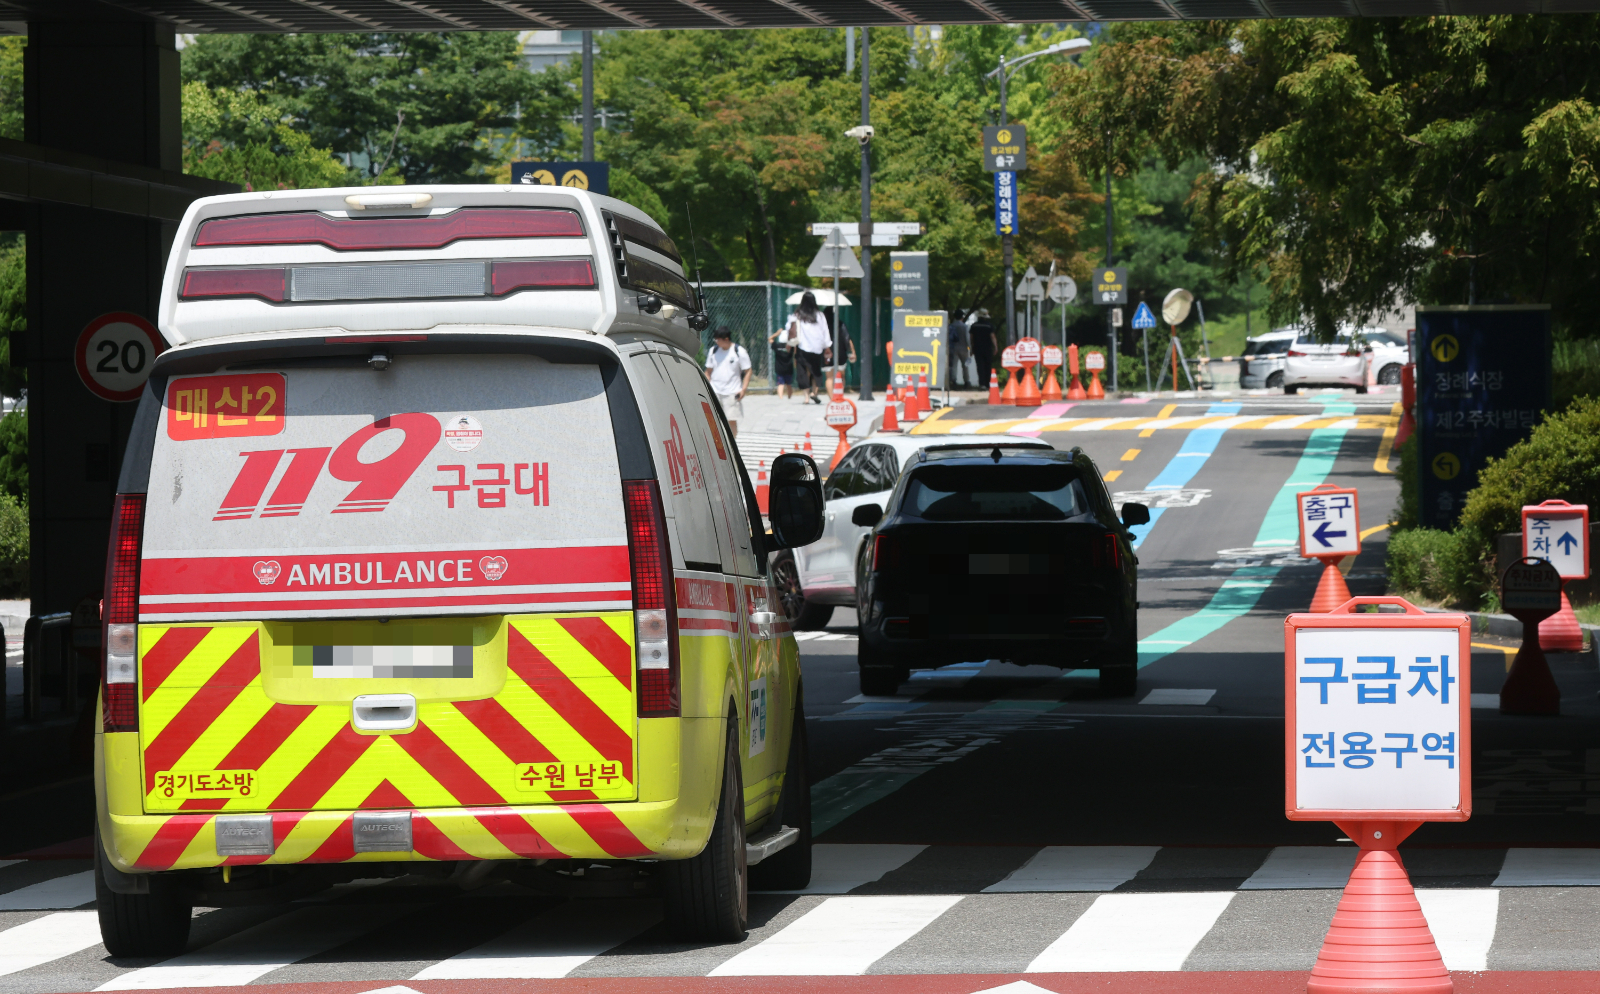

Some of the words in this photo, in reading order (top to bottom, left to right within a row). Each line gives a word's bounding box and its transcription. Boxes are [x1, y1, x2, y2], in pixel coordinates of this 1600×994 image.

[995, 156, 1016, 168] 출구
[998, 171, 1014, 226] 장례식장
[922, 327, 940, 337] 출구
[97, 340, 146, 374] 20
[1435, 370, 1503, 391] 장례식장
[174, 384, 277, 429] 매산2
[212, 412, 442, 521] 119
[432, 461, 551, 509] 구급대
[662, 413, 692, 496] 119
[1304, 495, 1352, 521] 출구
[287, 557, 475, 587] AMBULANCE
[1299, 655, 1455, 704] 구급차
[1300, 730, 1456, 770] 전용구역
[157, 771, 256, 798] 경기도소방
[519, 764, 566, 788] 수원
[574, 761, 622, 785] 남부
[221, 826, 265, 837] AUTECH
[360, 823, 404, 833] AUTECH
